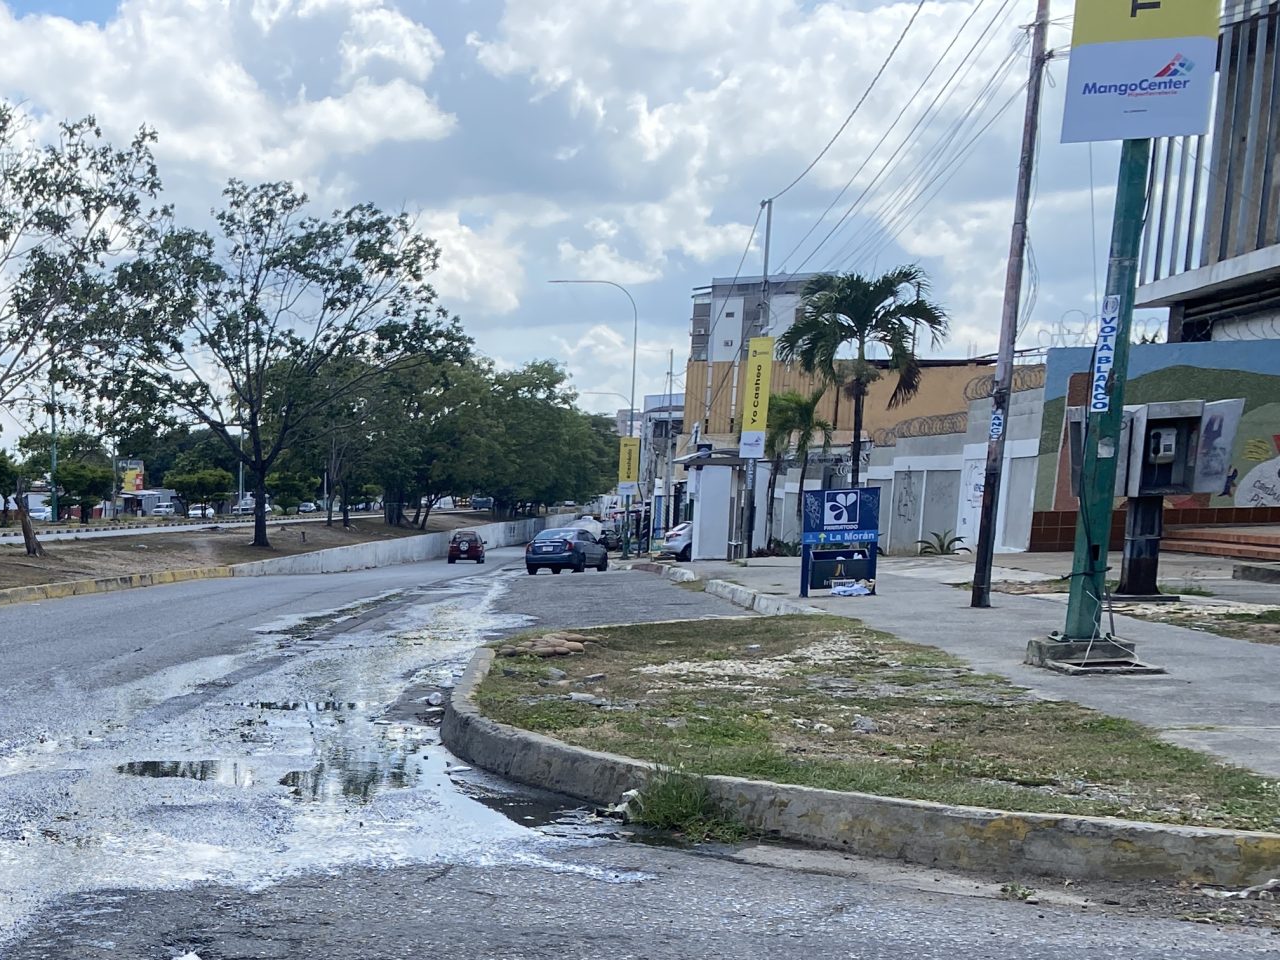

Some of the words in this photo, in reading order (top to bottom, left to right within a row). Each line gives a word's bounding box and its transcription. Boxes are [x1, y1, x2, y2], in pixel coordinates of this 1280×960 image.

[1082, 79, 1190, 95] MangoCenter
[1099, 317, 1117, 351] VOTA
[1093, 356, 1111, 410] BLANCO
[751, 411, 758, 424] Yo
[845, 532, 874, 540] Morán
